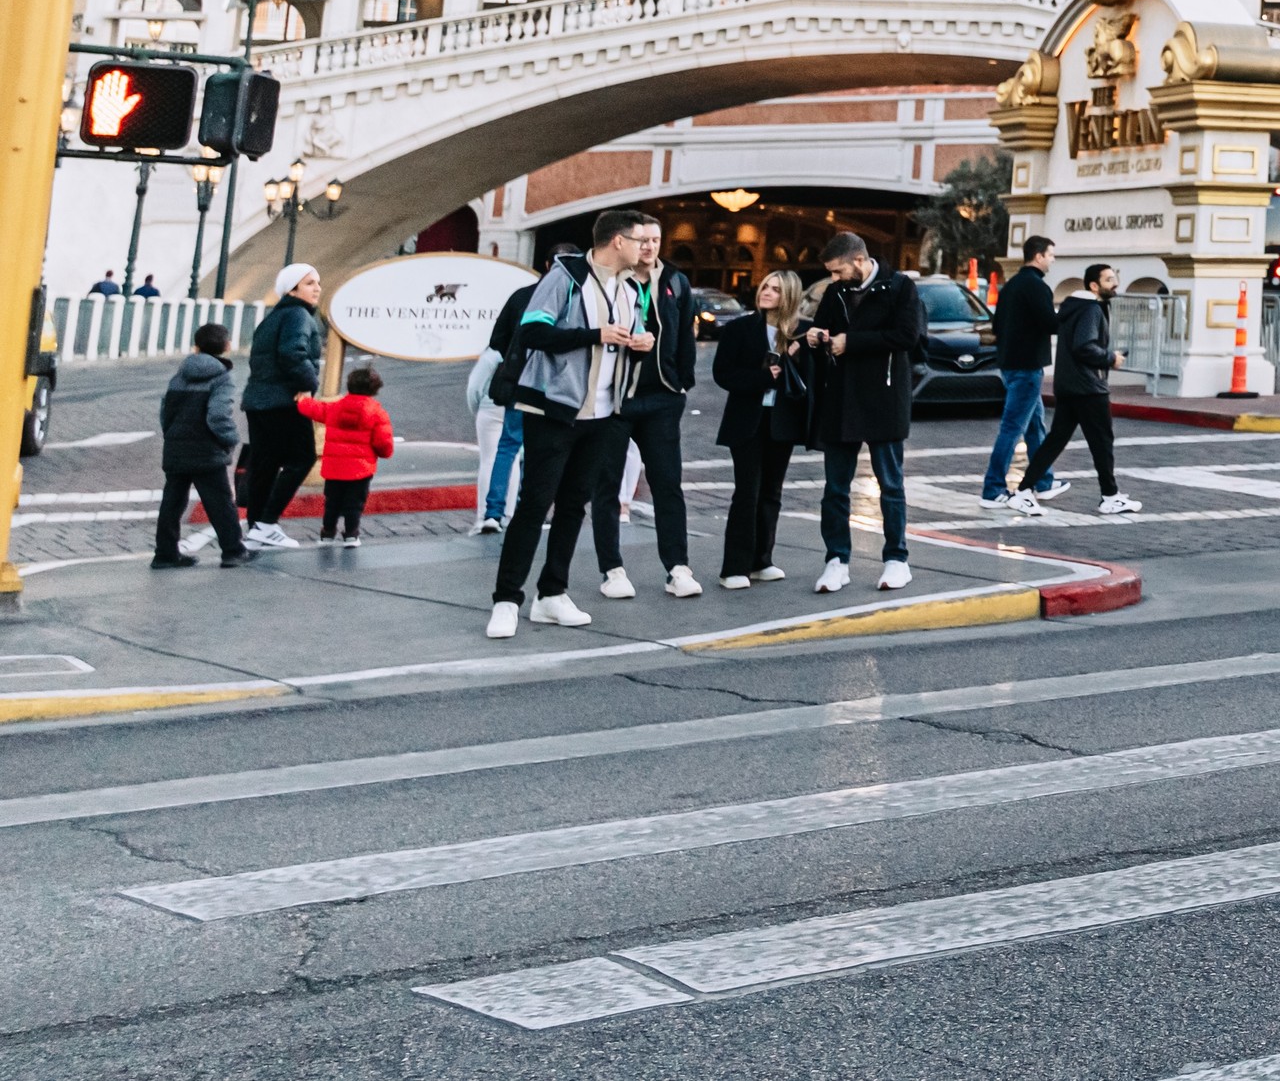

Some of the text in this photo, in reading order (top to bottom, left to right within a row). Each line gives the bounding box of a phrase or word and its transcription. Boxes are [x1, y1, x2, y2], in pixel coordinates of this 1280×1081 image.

[1091, 86, 1117, 106] THE
[346, 306, 380, 318] THE
[387, 307, 473, 319] VENETIAN
